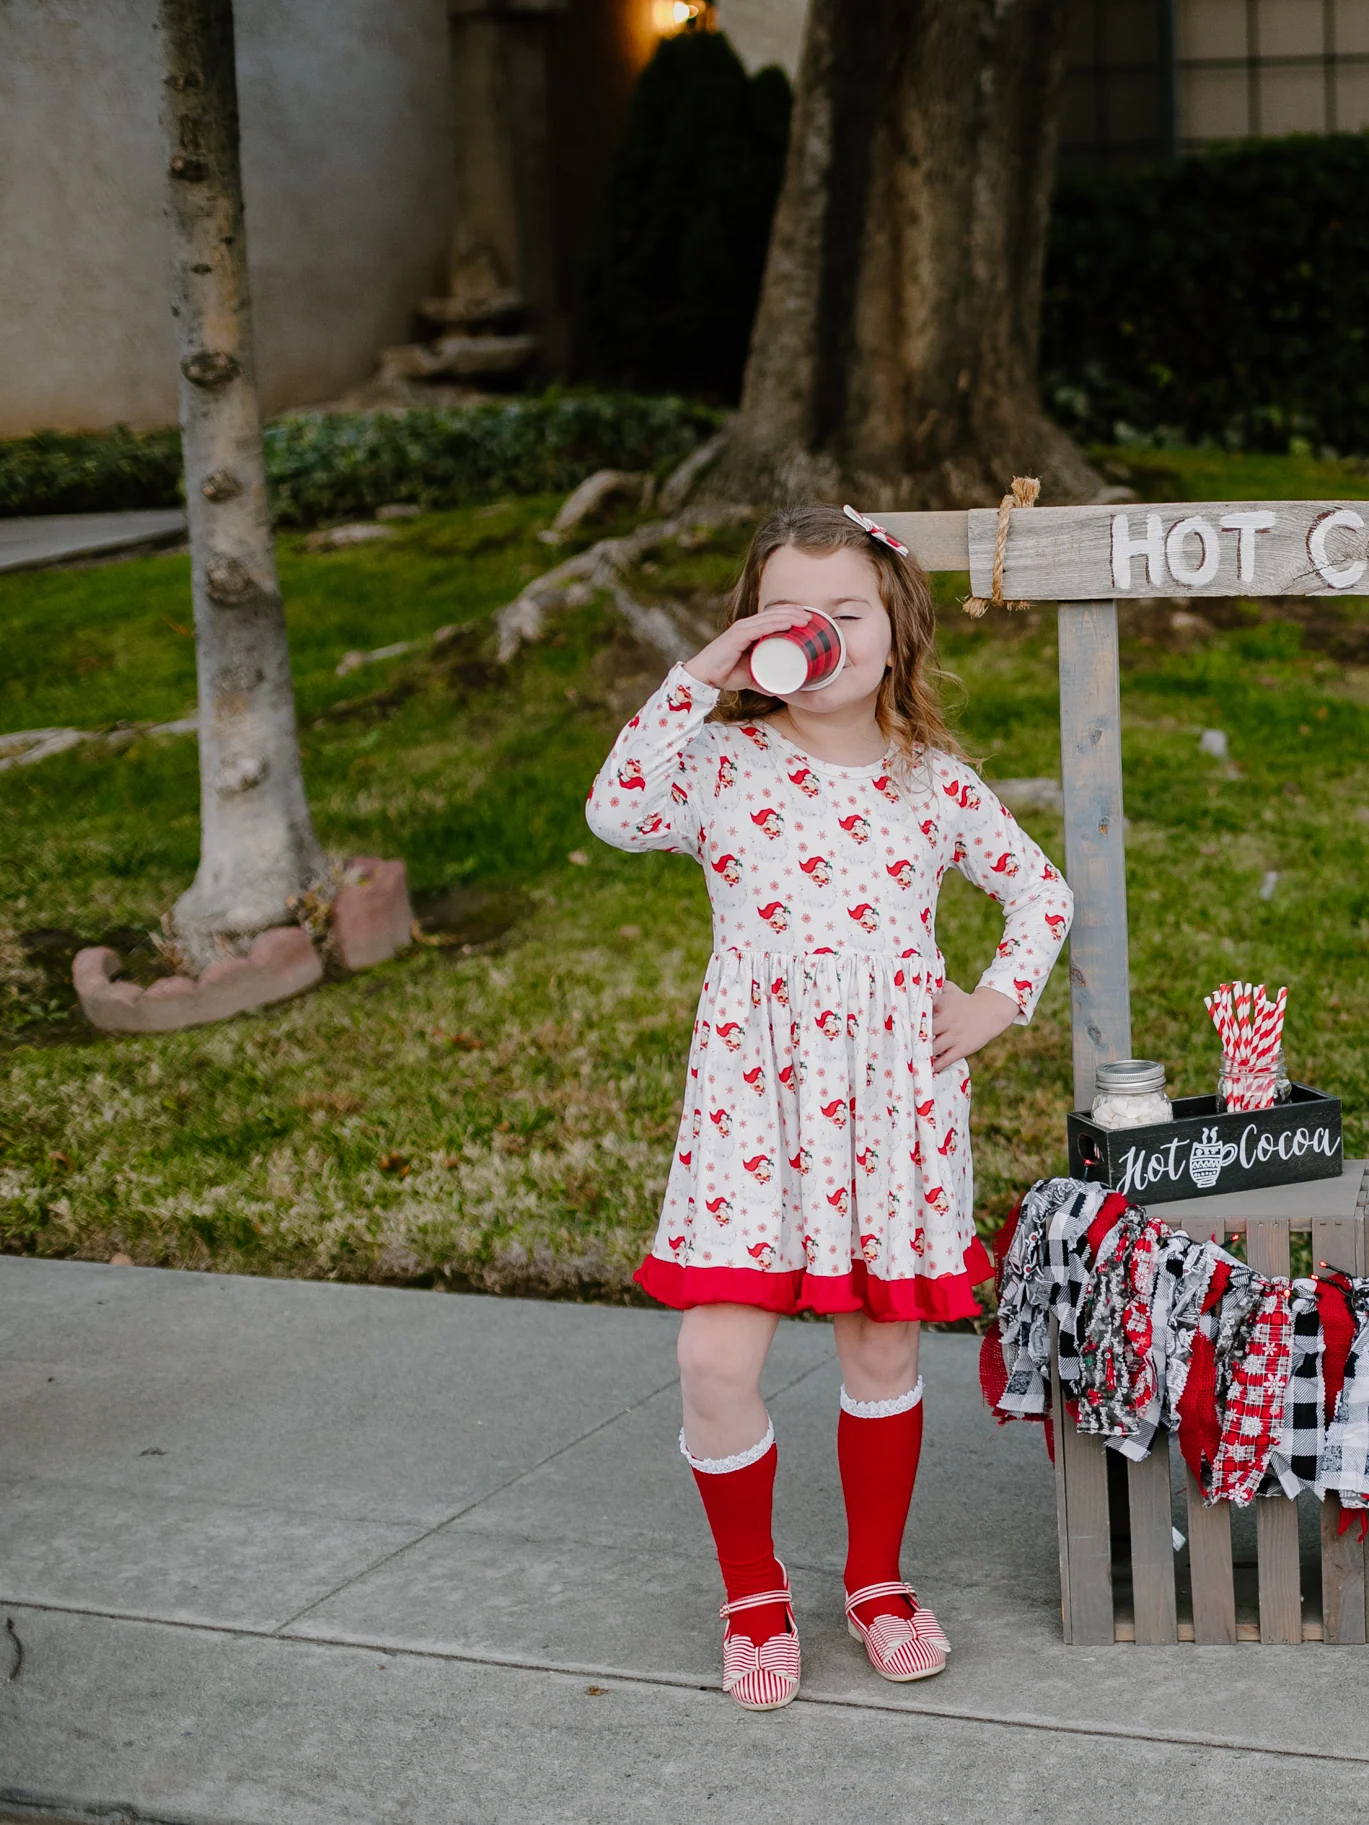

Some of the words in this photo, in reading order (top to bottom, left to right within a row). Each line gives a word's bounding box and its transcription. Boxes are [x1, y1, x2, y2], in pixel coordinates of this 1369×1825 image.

[1111, 510, 1278, 588] HOT
[1117, 1138, 1190, 1195] Hot
[1239, 1124, 1341, 1169] Cocoa
